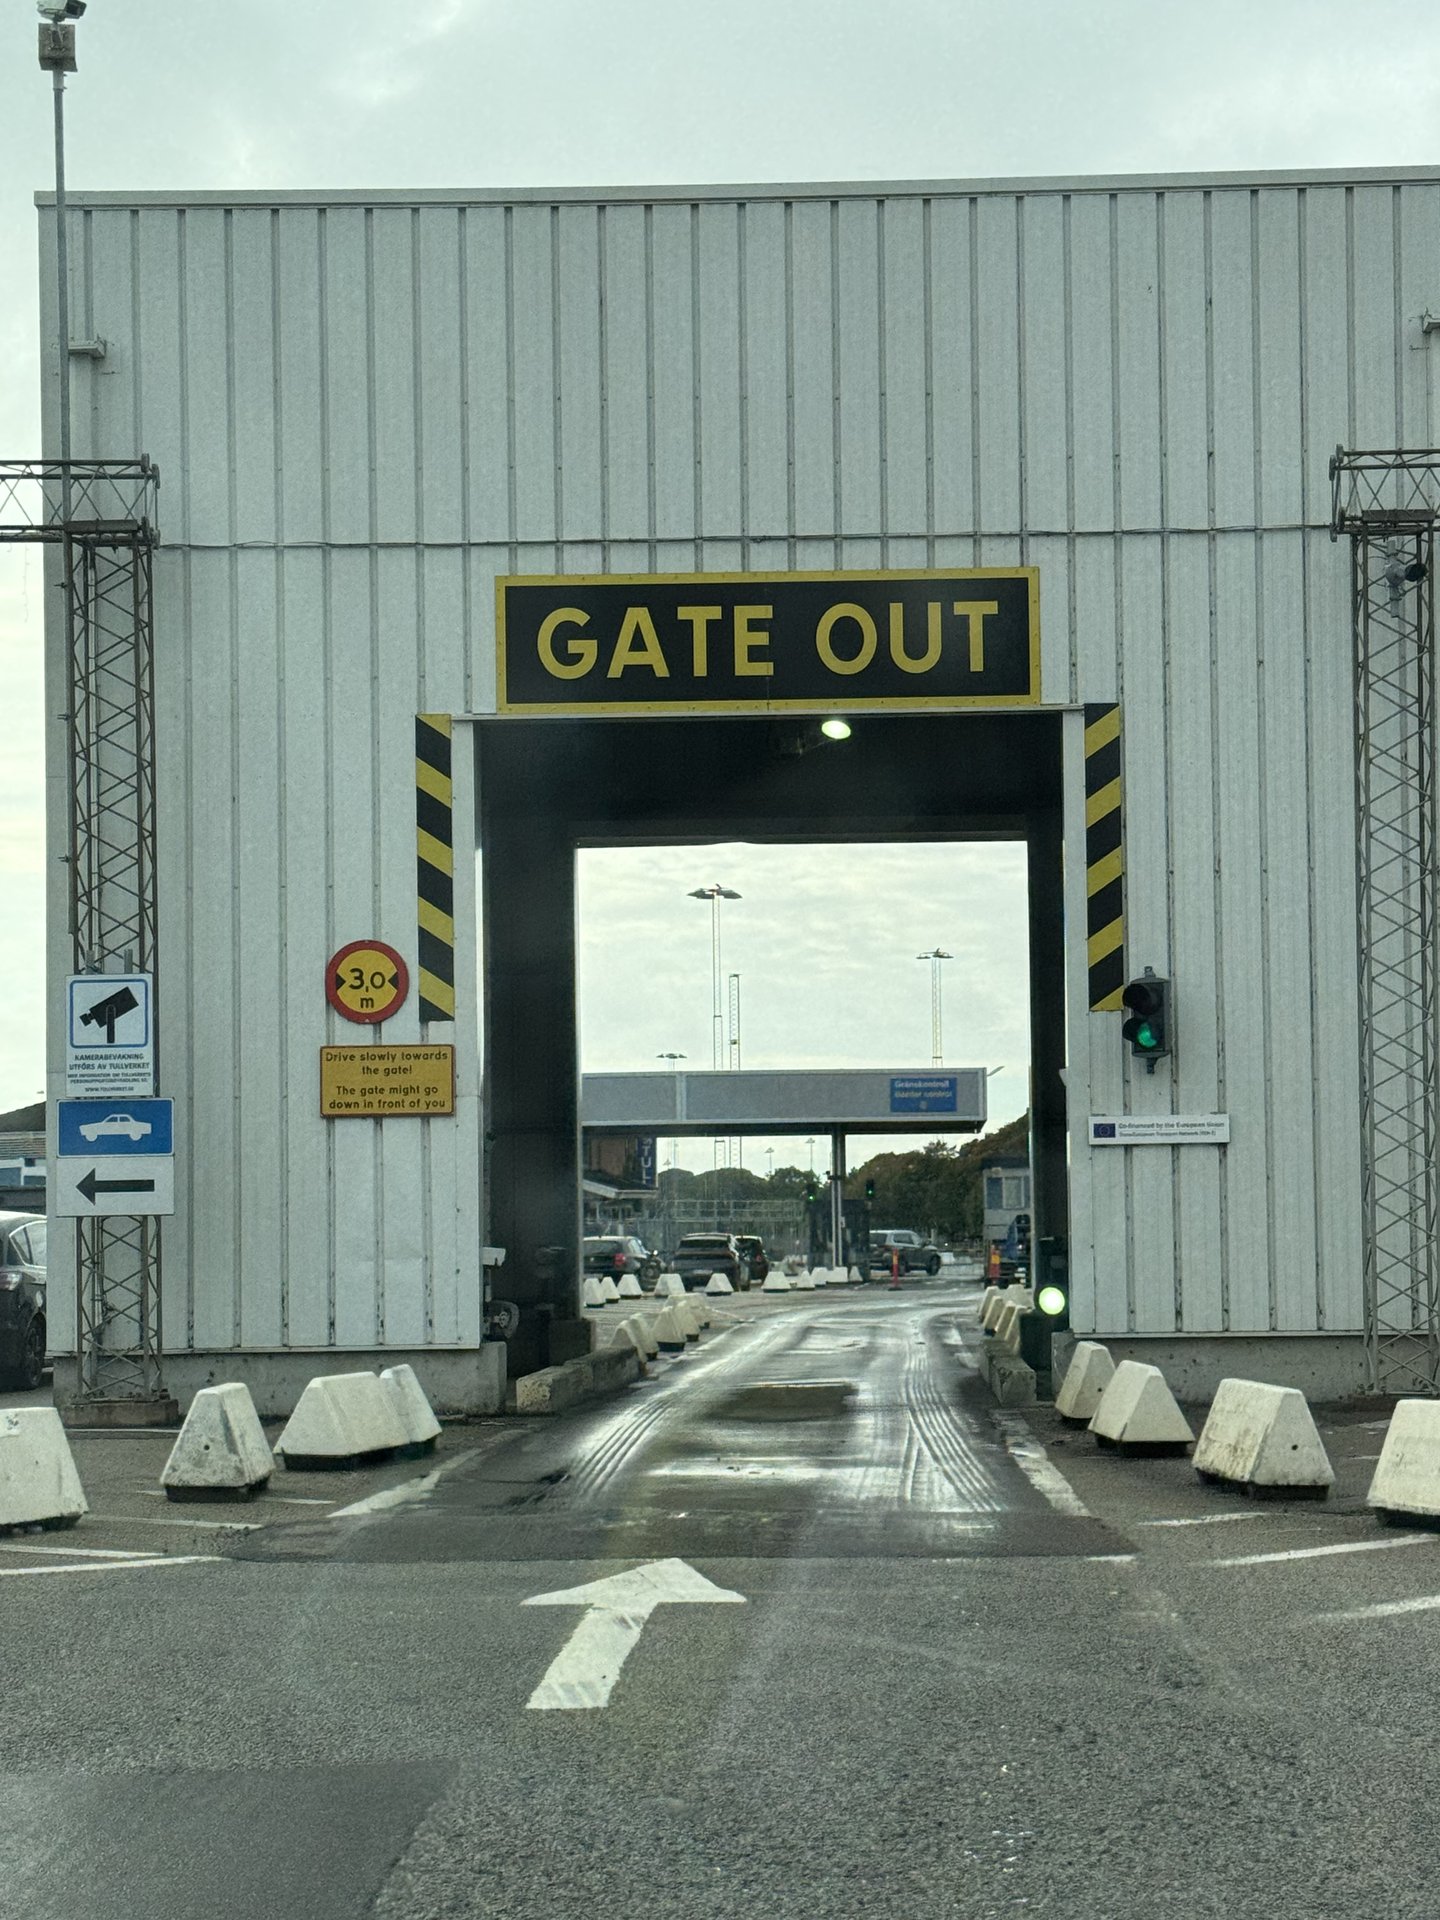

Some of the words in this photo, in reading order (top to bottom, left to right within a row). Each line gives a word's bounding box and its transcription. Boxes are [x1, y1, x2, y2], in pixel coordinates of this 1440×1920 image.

[537, 604, 775, 680] GATE
[815, 600, 998, 676] OUT
[348, 967, 386, 993] 3,0
[360, 996, 374, 1009] m
[326, 1051, 356, 1062] Drive
[360, 1051, 397, 1063] slowly
[401, 1050, 448, 1061] towards
[109, 1062, 150, 1070] TULLVERKET
[362, 1065, 379, 1075] the
[383, 1065, 412, 1077] gate!
[336, 1086, 356, 1095] The
[360, 1086, 385, 1097] gate
[389, 1084, 420, 1096] might
[424, 1087, 438, 1096] go
[329, 1099, 360, 1109] down
[363, 1099, 374, 1109] in
[378, 1098, 405, 1109] front
[409, 1098, 421, 1108] of
[424, 1099, 445, 1109] you
[1156, 1122, 1164, 1130] by
